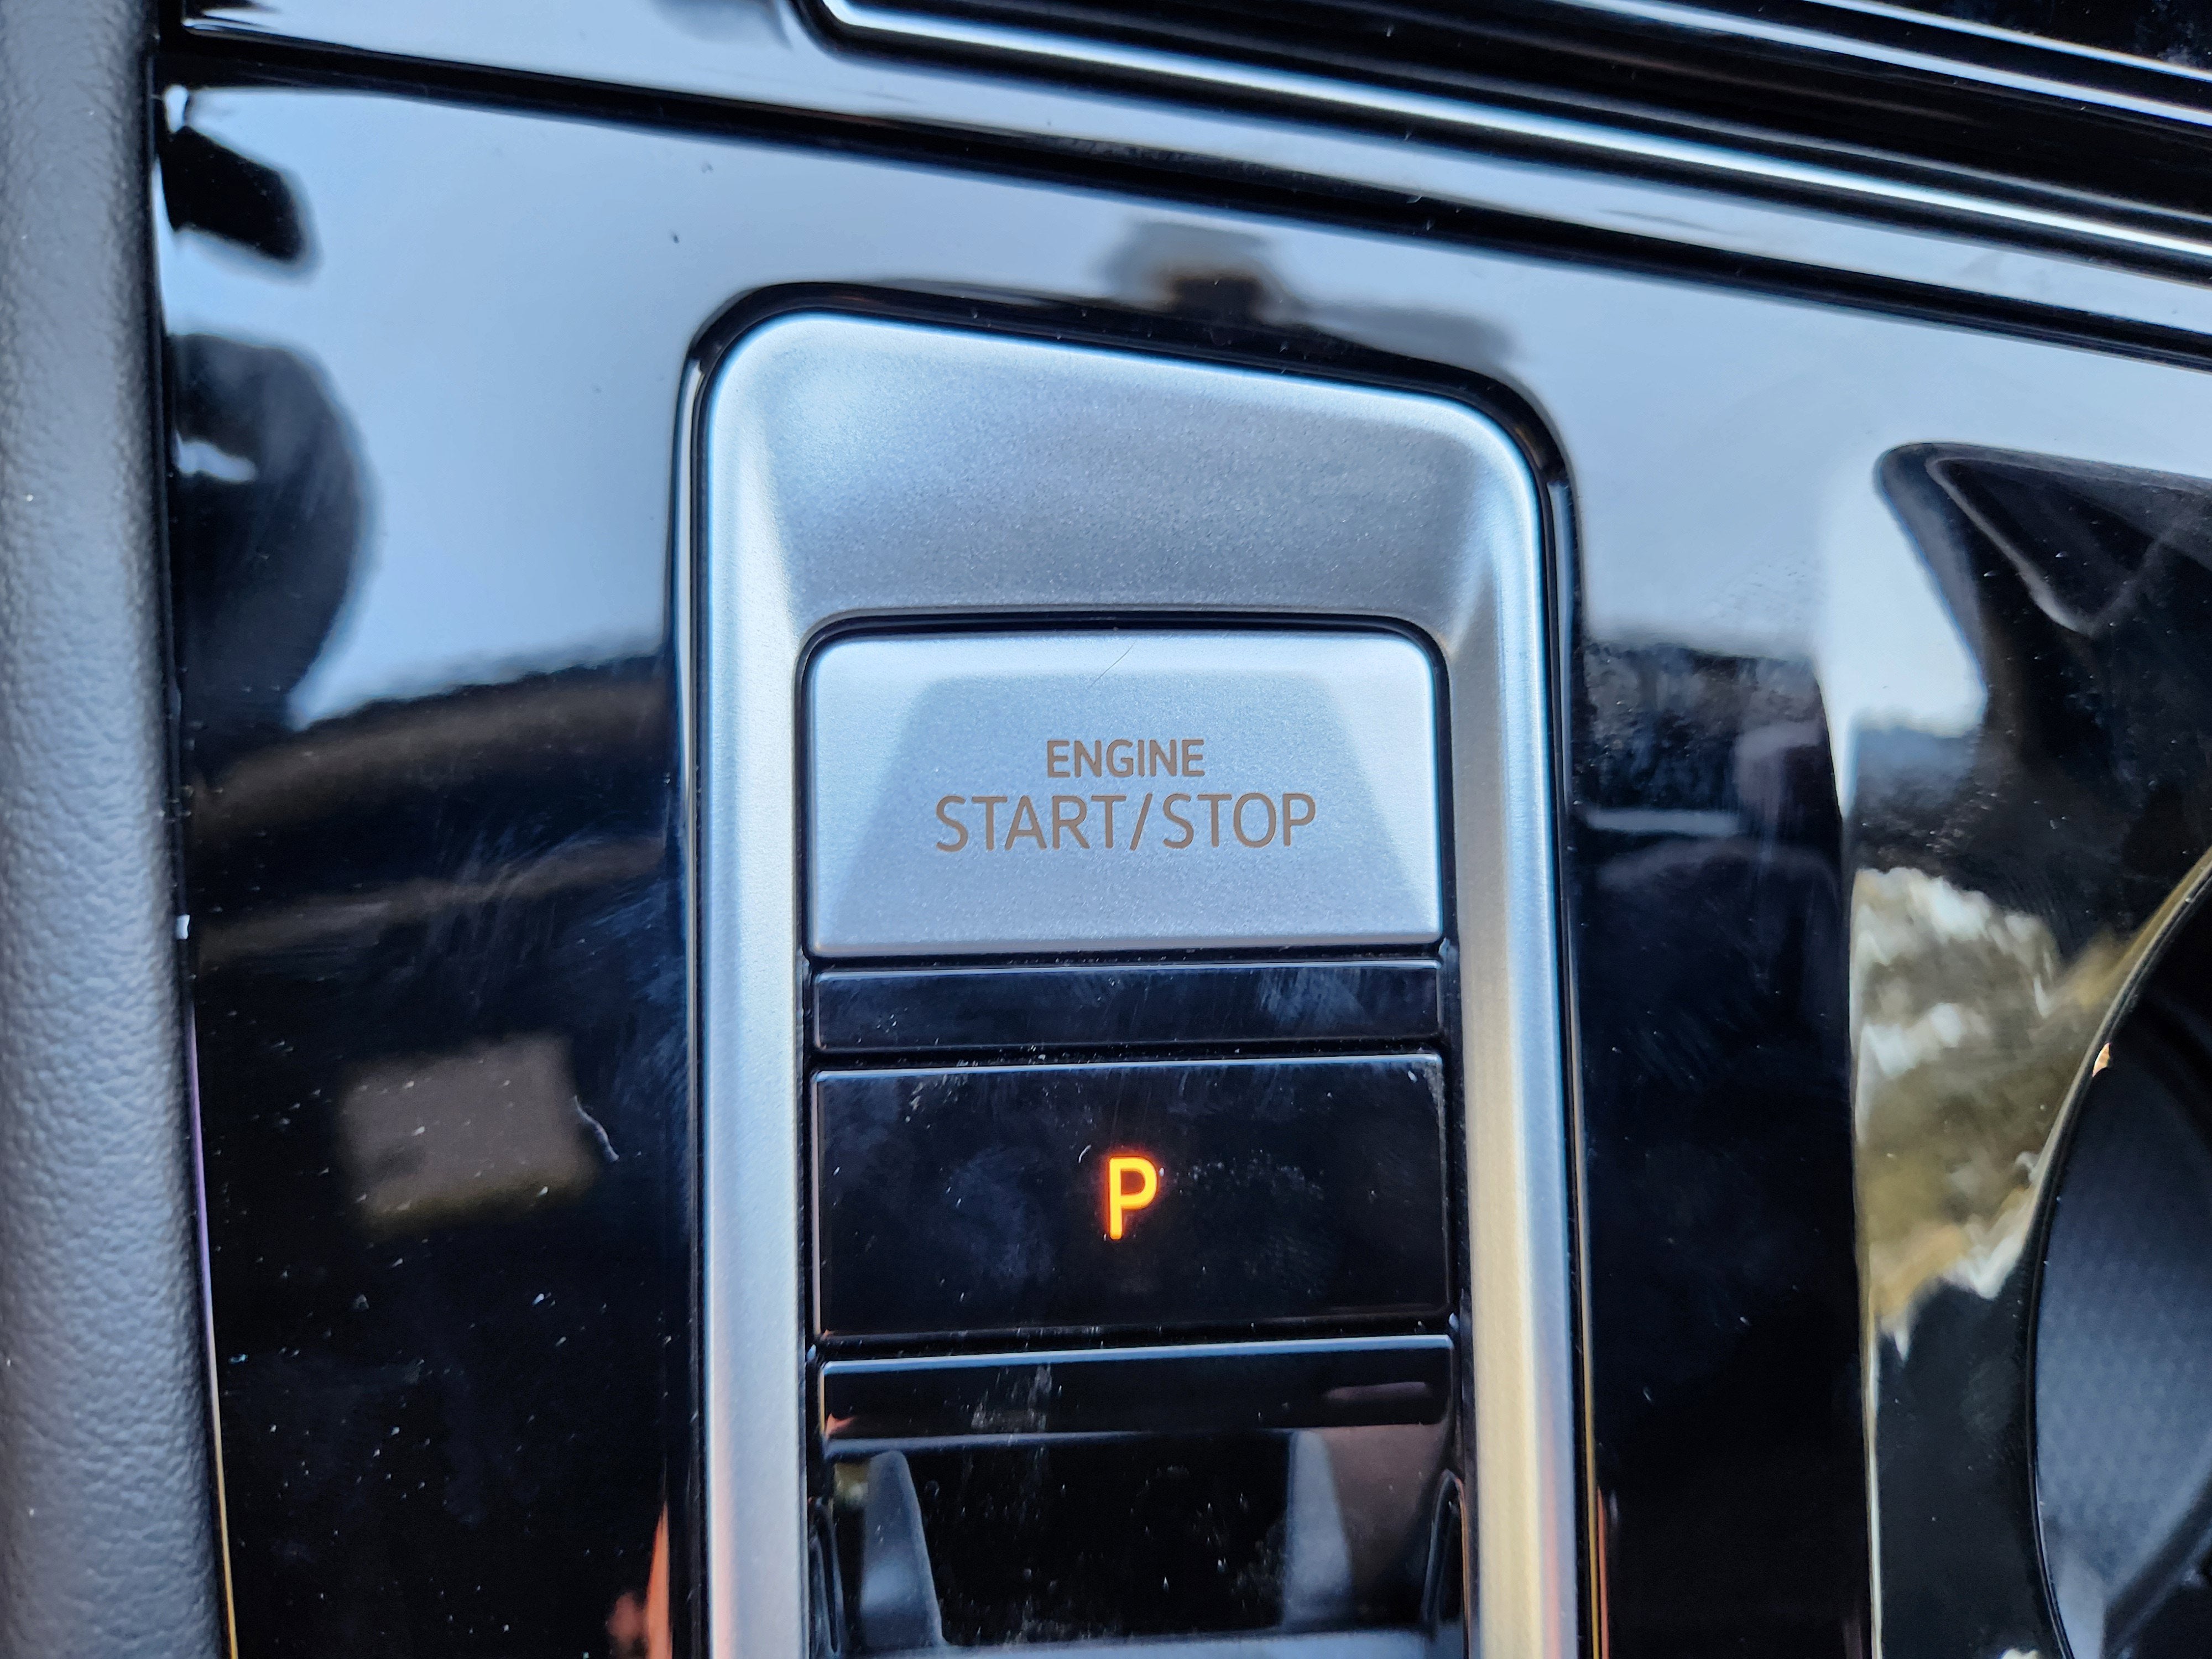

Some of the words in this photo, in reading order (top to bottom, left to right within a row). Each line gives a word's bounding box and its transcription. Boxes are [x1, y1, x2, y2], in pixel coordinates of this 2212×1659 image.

[1047, 738, 1205, 778] ENGINE
[935, 792, 1317, 852] START/STOP
[1105, 1155, 1160, 1240] P
